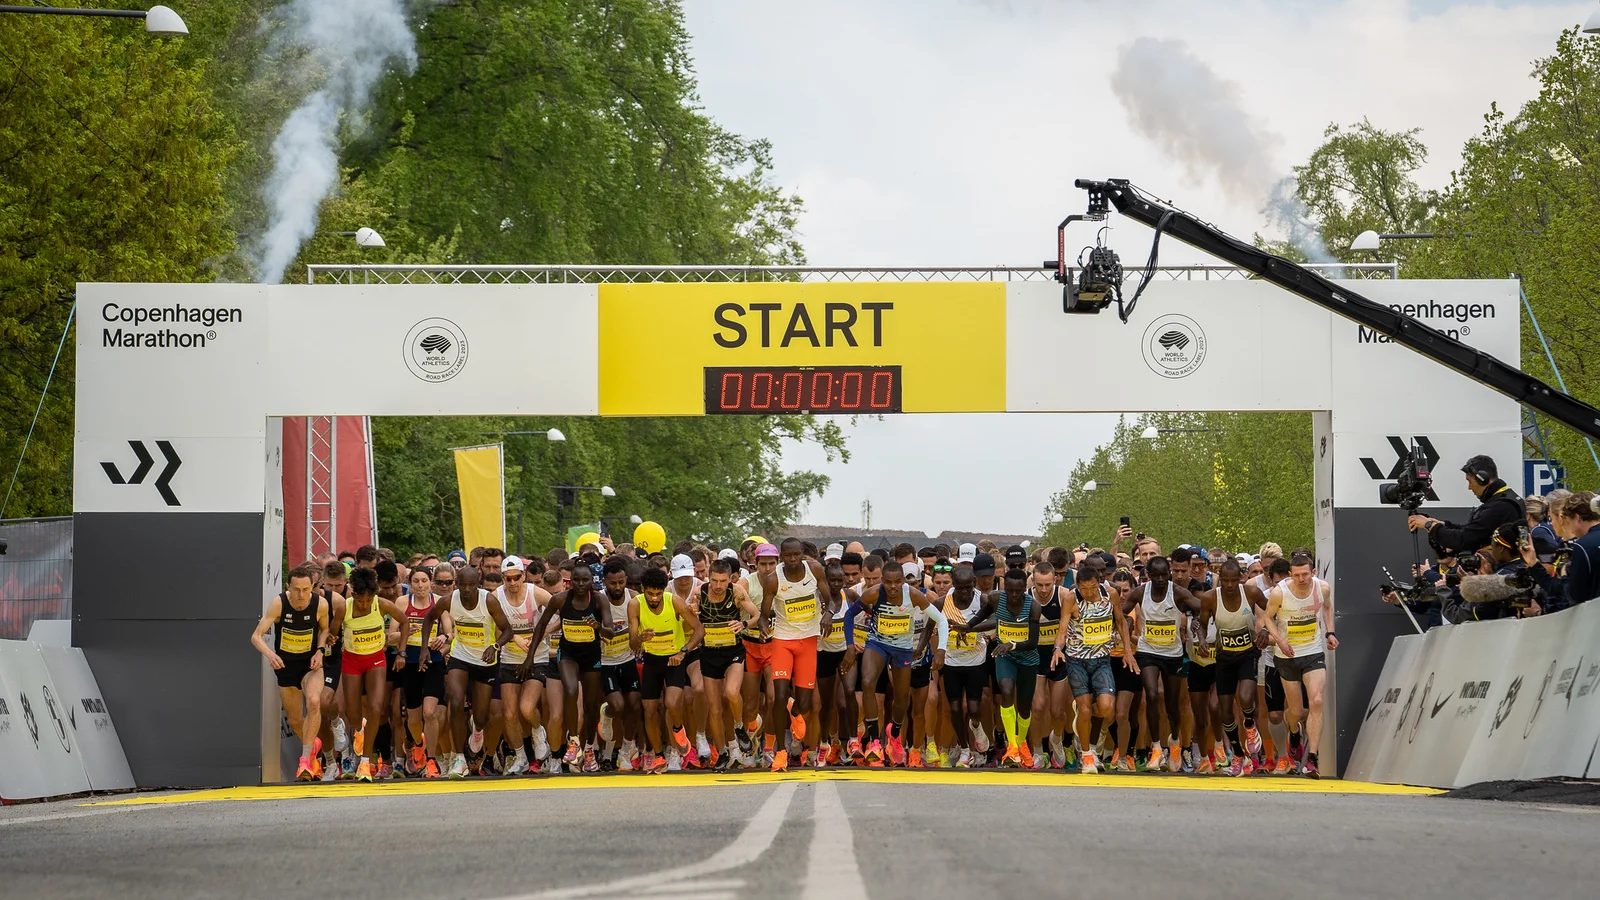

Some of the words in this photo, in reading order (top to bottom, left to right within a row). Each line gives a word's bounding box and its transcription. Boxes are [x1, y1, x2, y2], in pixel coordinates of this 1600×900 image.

[102, 302, 242, 326] Copenhagen
[713, 302, 894, 348] START
[721, 372, 893, 409] 00:00:00
[1533, 463, 1557, 497] P
[787, 603, 815, 614] Chumo
[457, 629, 485, 638] Karanja
[999, 629, 1028, 637] Kipruto
[1085, 624, 1112, 634] Ochir
[1146, 627, 1175, 636] Keter
[354, 634, 382, 643] Aberta
[1222, 633, 1251, 647] PACE
